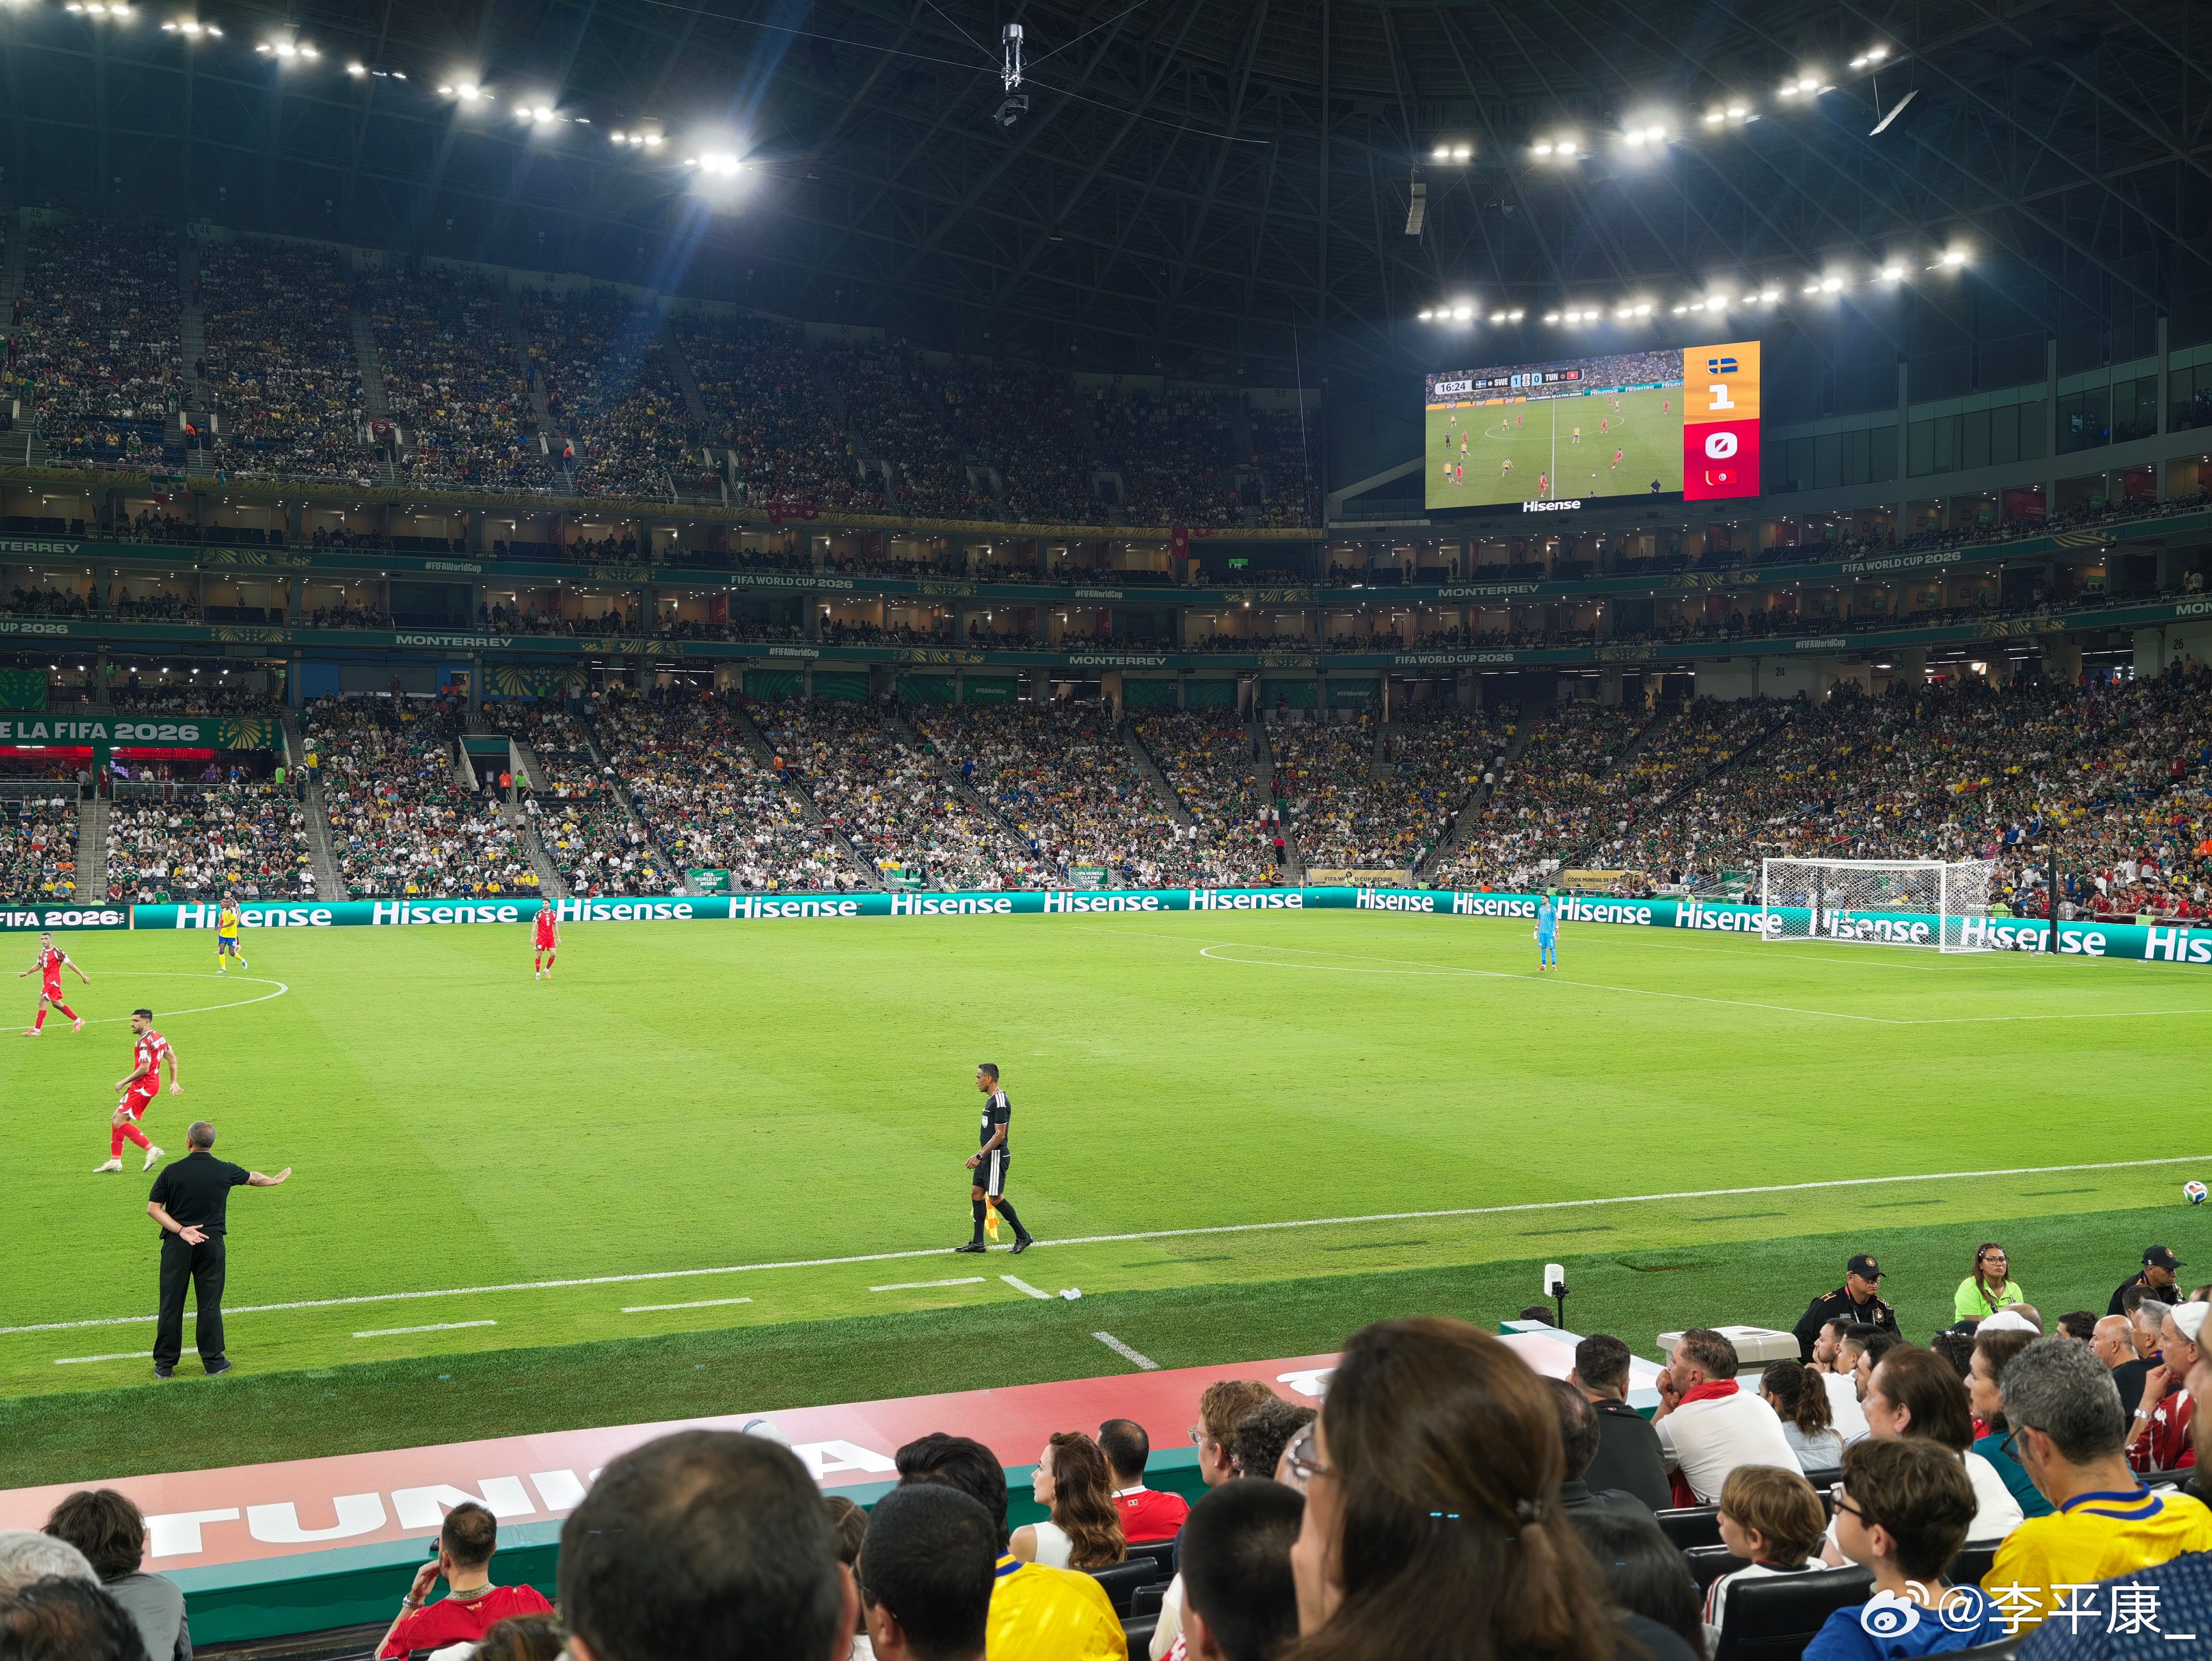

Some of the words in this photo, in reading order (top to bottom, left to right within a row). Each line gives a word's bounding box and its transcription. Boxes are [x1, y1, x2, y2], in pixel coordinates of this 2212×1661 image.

[1441, 382, 1465, 392] 16:24
[1494, 378, 1508, 386] SWE
[1709, 384, 1734, 410] 1
[1523, 500, 1580, 512] Hisense
[425, 562, 481, 573] #FIFAWorldCup
[1842, 563, 1864, 573] FIFA
[1867, 558, 1901, 570] WORLD
[1903, 556, 1923, 566] CUP
[1925, 551, 1962, 564] 2026
[731, 576, 754, 584] FIFA
[756, 576, 793, 585] WORLD
[796, 578, 816, 587] CUP
[818, 579, 853, 589] 2026
[1076, 590, 1122, 600] #FIFAWorldCup
[1438, 584, 1540, 597] MONTERREY
[21, 623, 68, 634] 2026
[396, 635, 512, 647] MONTERREY
[1796, 639, 1846, 649] #FIFAWorldCup
[2174, 639, 2183, 649] 26
[769, 648, 819, 658] #FIFAWorldCup
[1396, 656, 1417, 664] FIFA
[1419, 655, 1455, 664] WORLD
[1457, 654, 1476, 663] CUP
[1478, 653, 1514, 662] 2026
[1069, 656, 1166, 665] MONTERREY
[1895, 660, 1904, 670] 25
[644, 667, 653, 677] 20
[1604, 674, 1612, 683] 24
[1776, 667, 1785, 676] 24
[18, 722, 49, 738] LA
[55, 722, 108, 739] FIFA
[114, 723, 199, 741] 2026
[890, 894, 1012, 915] Hisense
[1044, 891, 1158, 912] Hisense
[1189, 890, 1302, 910] Hisense
[1356, 889, 1434, 912] Hisense
[1453, 891, 1535, 918] Hisense
[372, 902, 517, 925] Hisense
[556, 898, 693, 922] Hisense
[729, 897, 858, 918] Hisense
[1557, 897, 1651, 925] Hisense
[45, 911, 118, 925] 2026
[176, 904, 332, 928] Hiense
[1675, 903, 1783, 933] Hisense
[1961, 918, 2106, 955] Hisense
[143, 1439, 896, 1559] TUNIA
